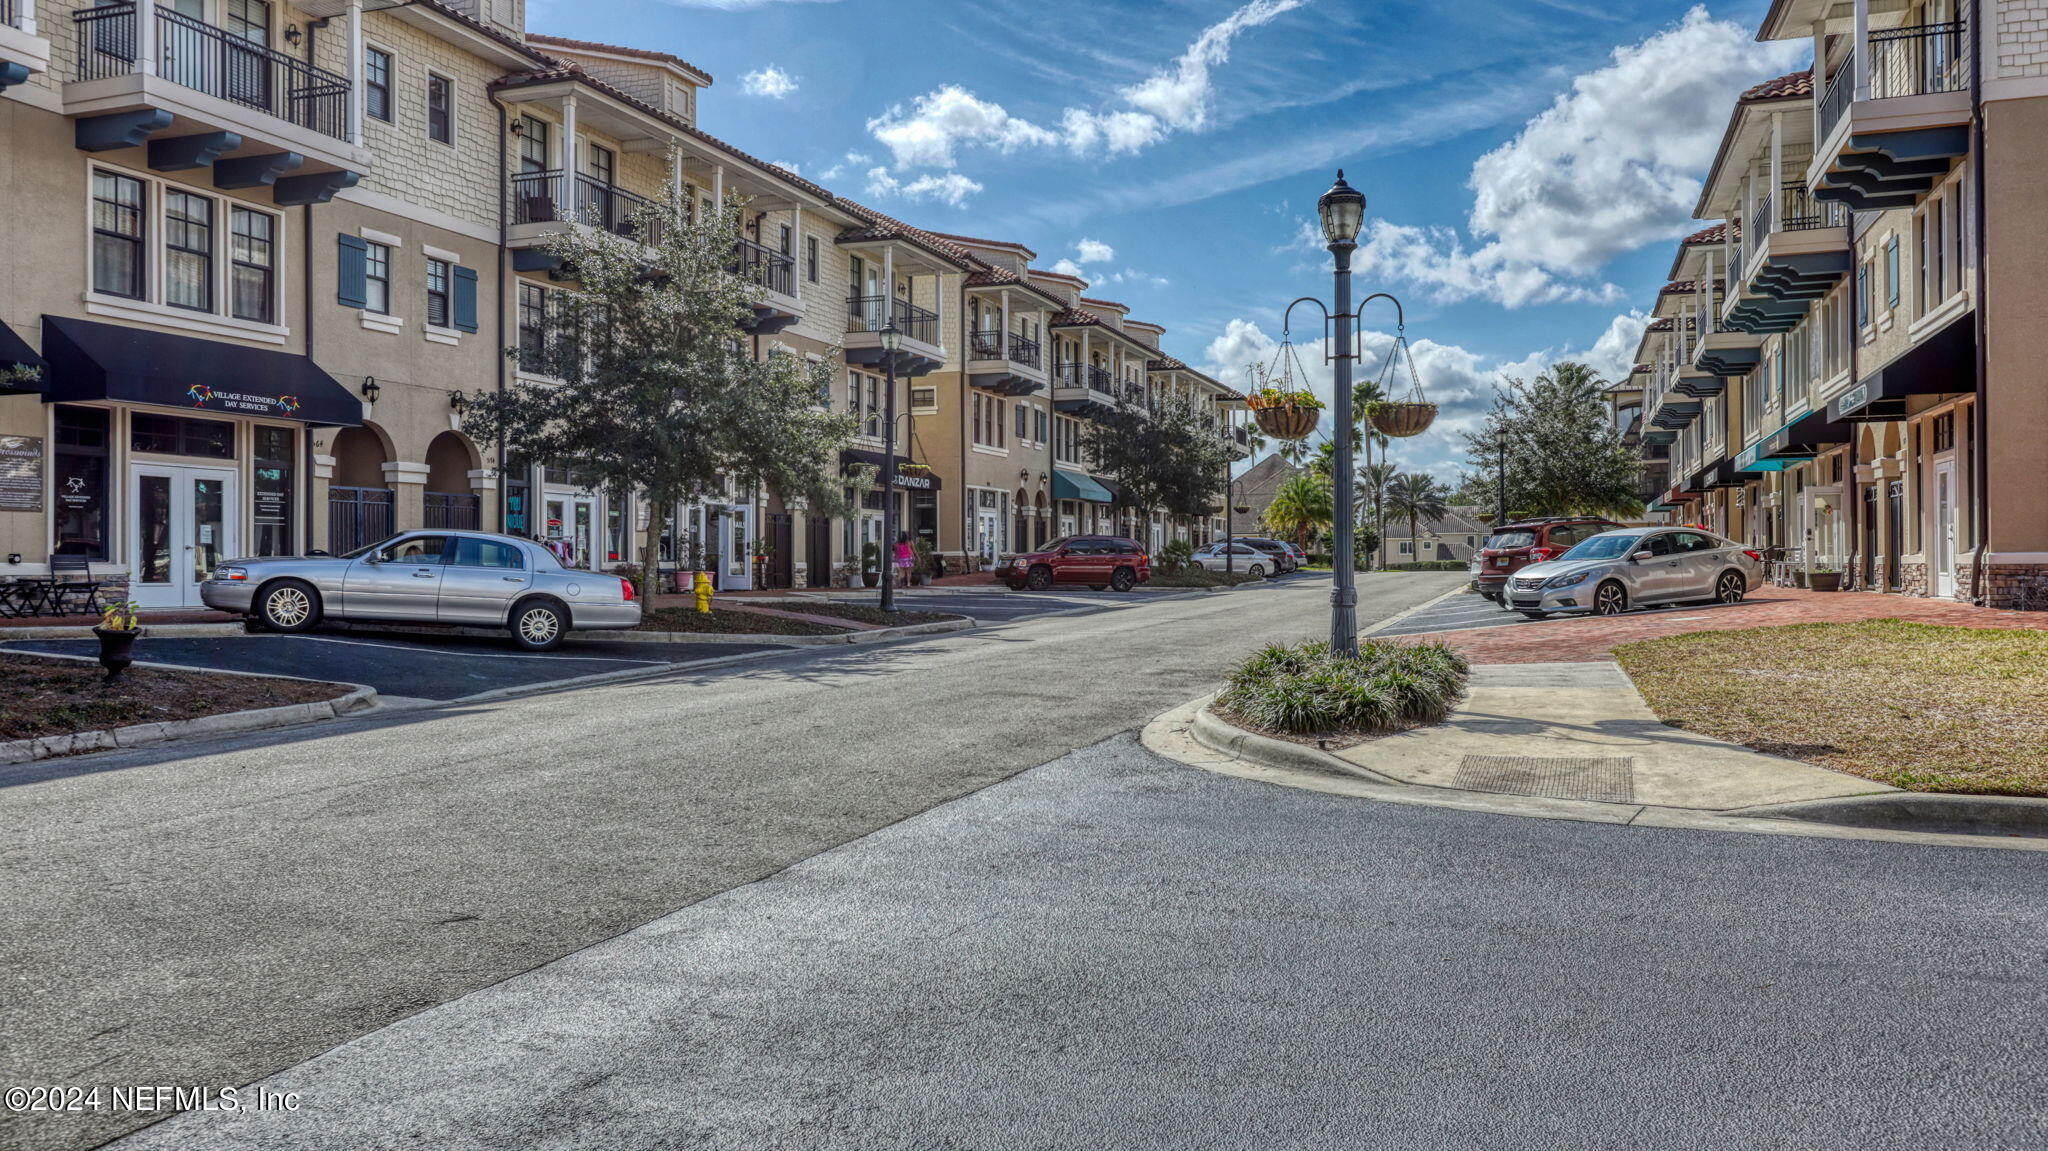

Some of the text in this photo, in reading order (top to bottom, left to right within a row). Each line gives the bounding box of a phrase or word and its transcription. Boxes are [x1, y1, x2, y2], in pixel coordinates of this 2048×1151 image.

[213, 391, 277, 405] VILLAGE EXTENDED
[224, 400, 269, 412] DAY SERVICES
[898, 474, 930, 489] DANZAR
